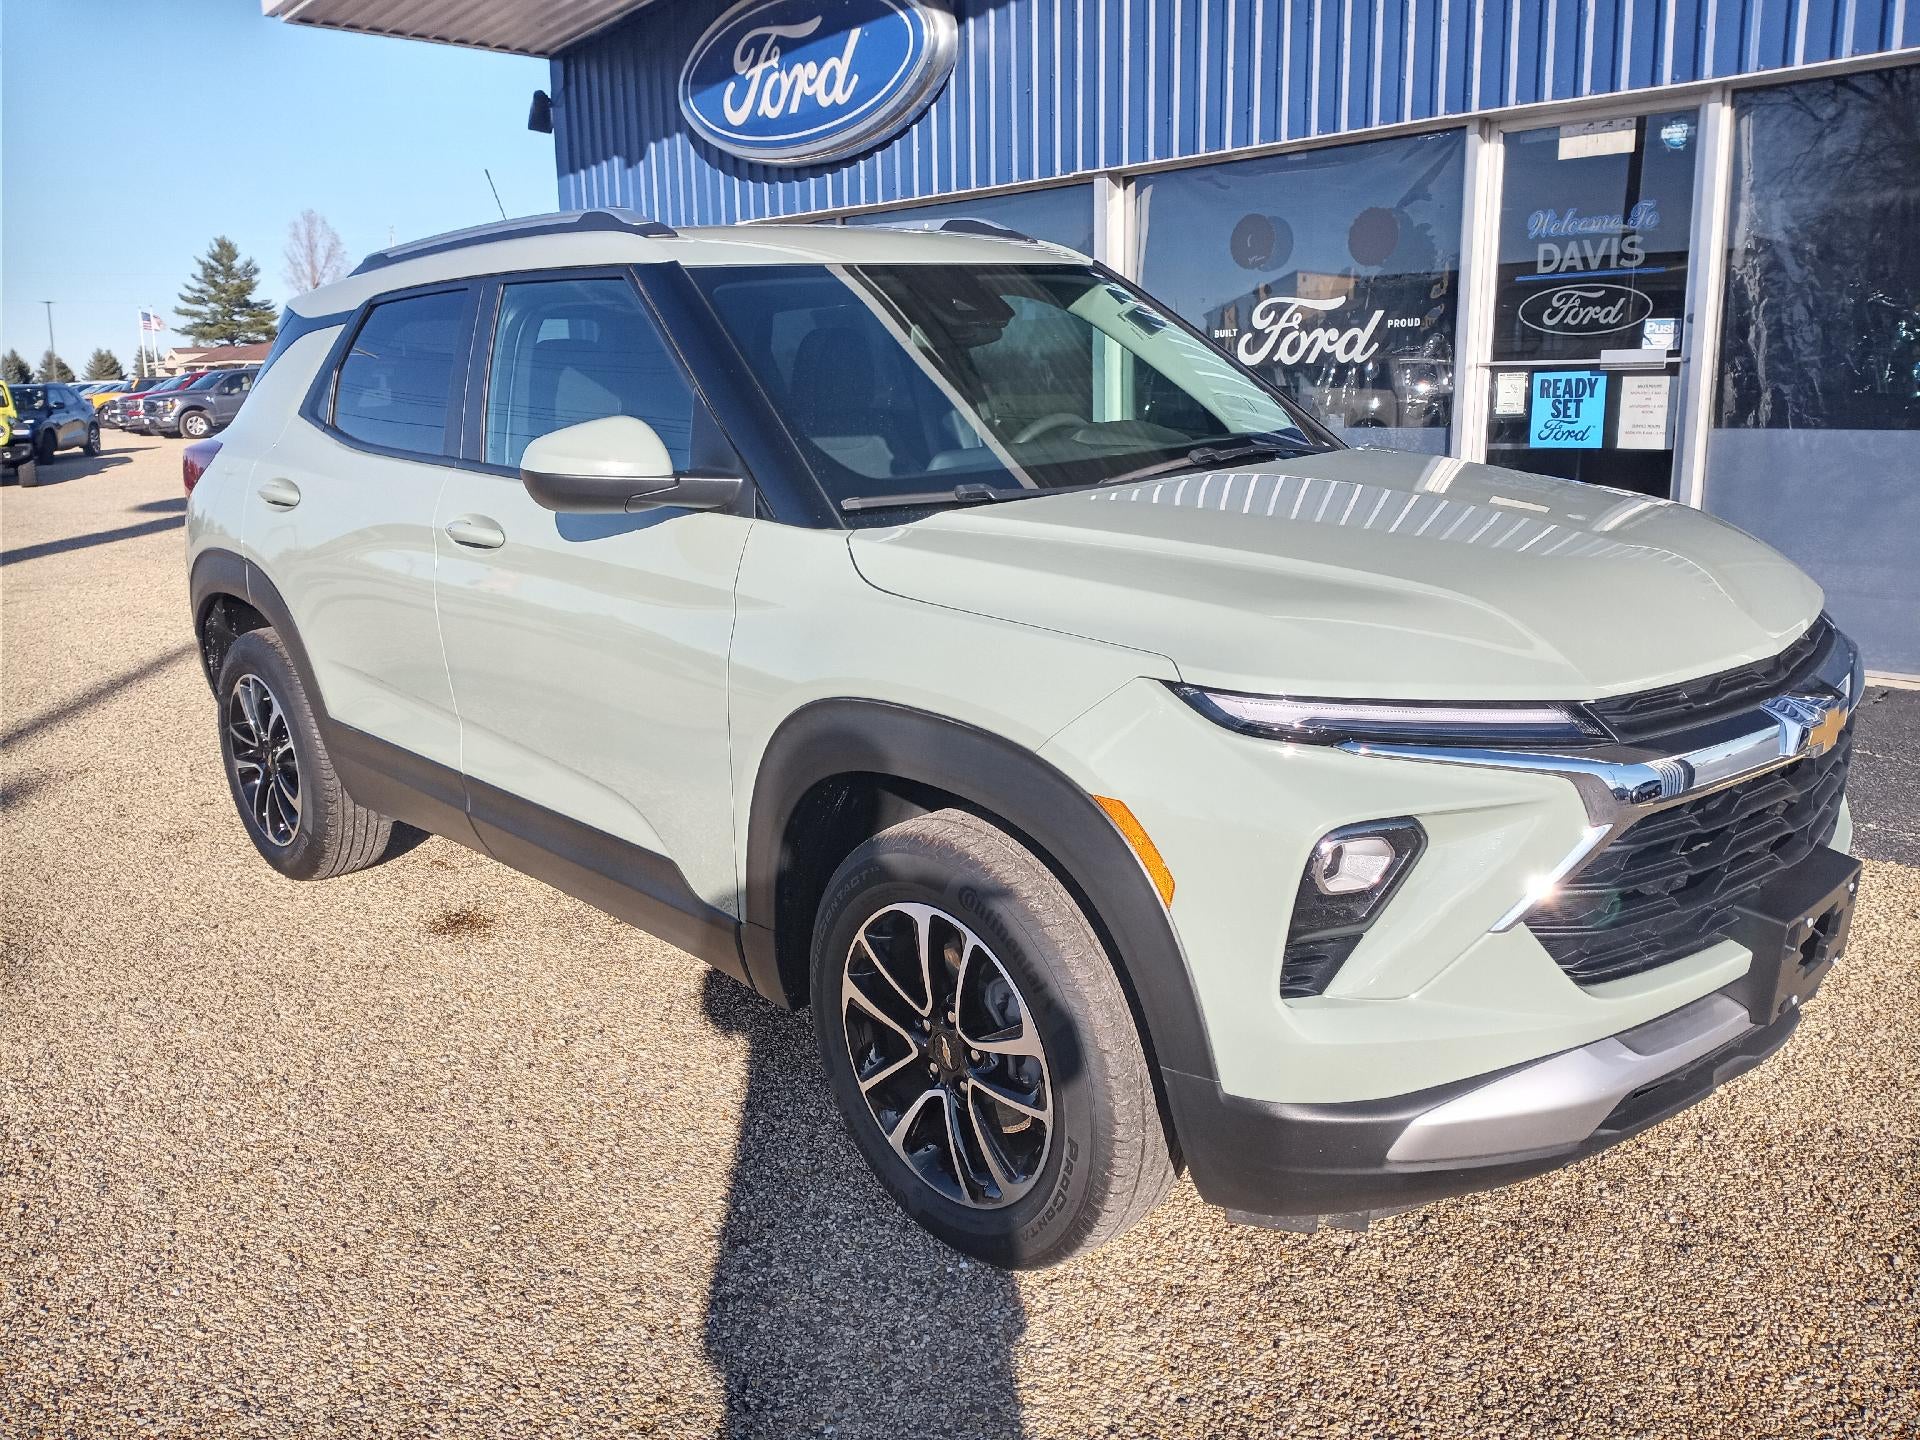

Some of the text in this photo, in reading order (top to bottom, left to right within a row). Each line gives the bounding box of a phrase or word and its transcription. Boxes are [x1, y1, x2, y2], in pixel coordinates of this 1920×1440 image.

[722, 15, 862, 126] Ford
[1527, 199, 1660, 239] Welcome To
[1537, 234, 1646, 274] DAVIS
[1542, 289, 1626, 326] Ford
[1214, 295, 1421, 366] BUILT Ford PROUD
[1540, 377, 1599, 399] READY
[1550, 398, 1584, 419] SET
[1538, 419, 1592, 441] Ford
